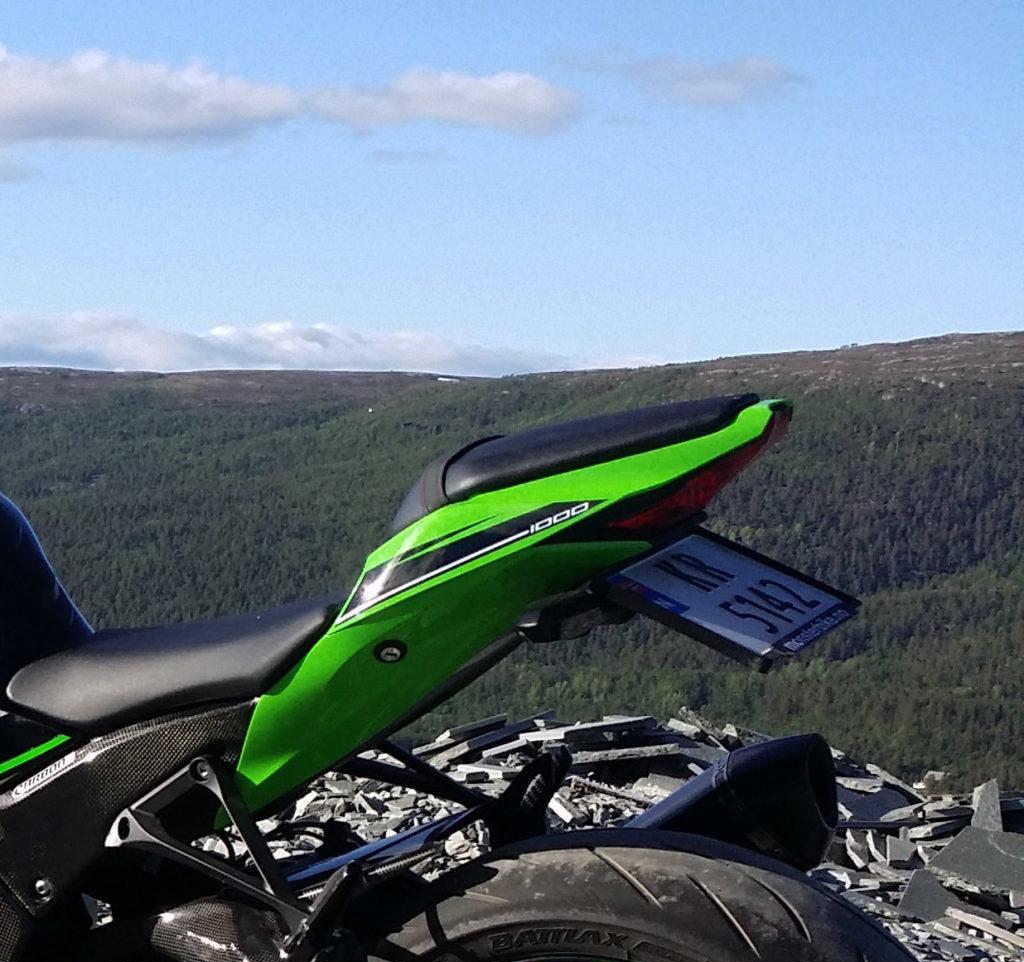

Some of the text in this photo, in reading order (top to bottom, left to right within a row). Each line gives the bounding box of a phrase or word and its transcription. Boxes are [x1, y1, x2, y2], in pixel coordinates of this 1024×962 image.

[530, 502, 589, 534] 1000
[718, 579, 821, 634] 5142
[488, 928, 629, 951] BATTLAX
